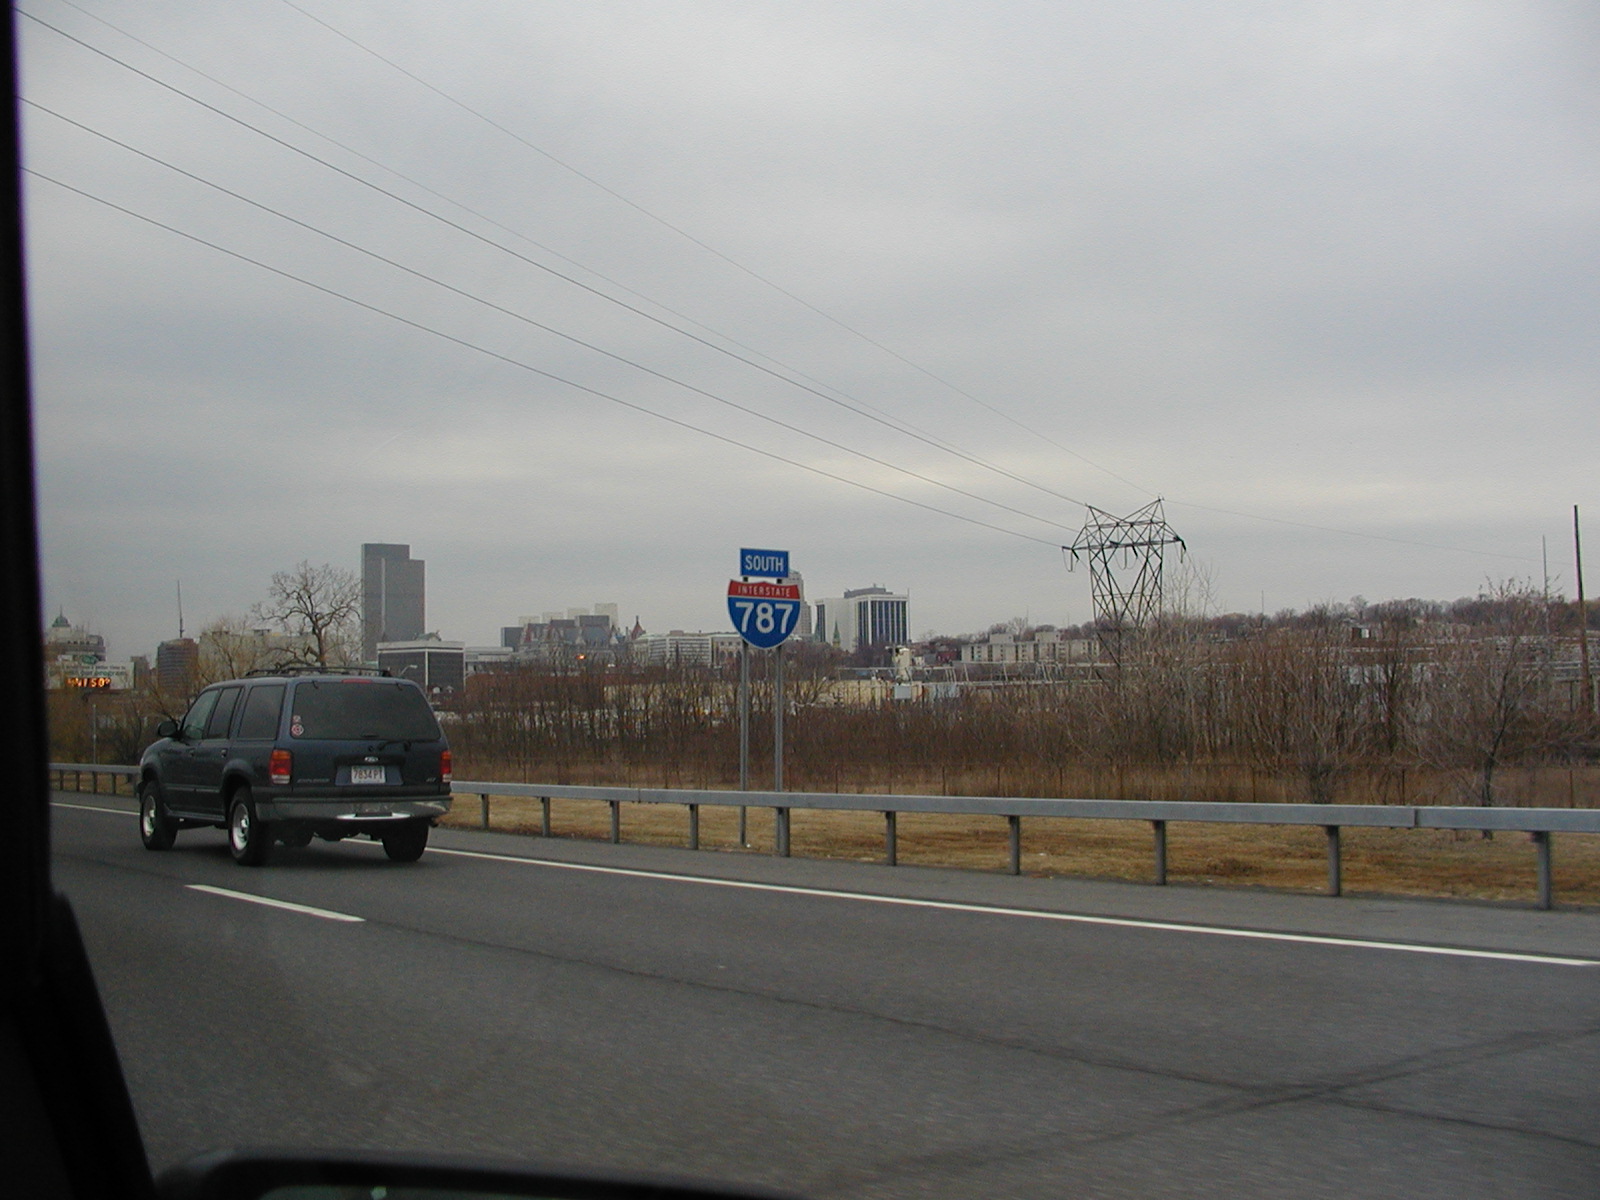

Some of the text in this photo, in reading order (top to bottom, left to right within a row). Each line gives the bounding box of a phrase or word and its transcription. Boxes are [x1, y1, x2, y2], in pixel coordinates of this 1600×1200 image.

[745, 555, 784, 572] SOUTH
[738, 585, 791, 597] INTERSTATE
[735, 602, 793, 634] 787
